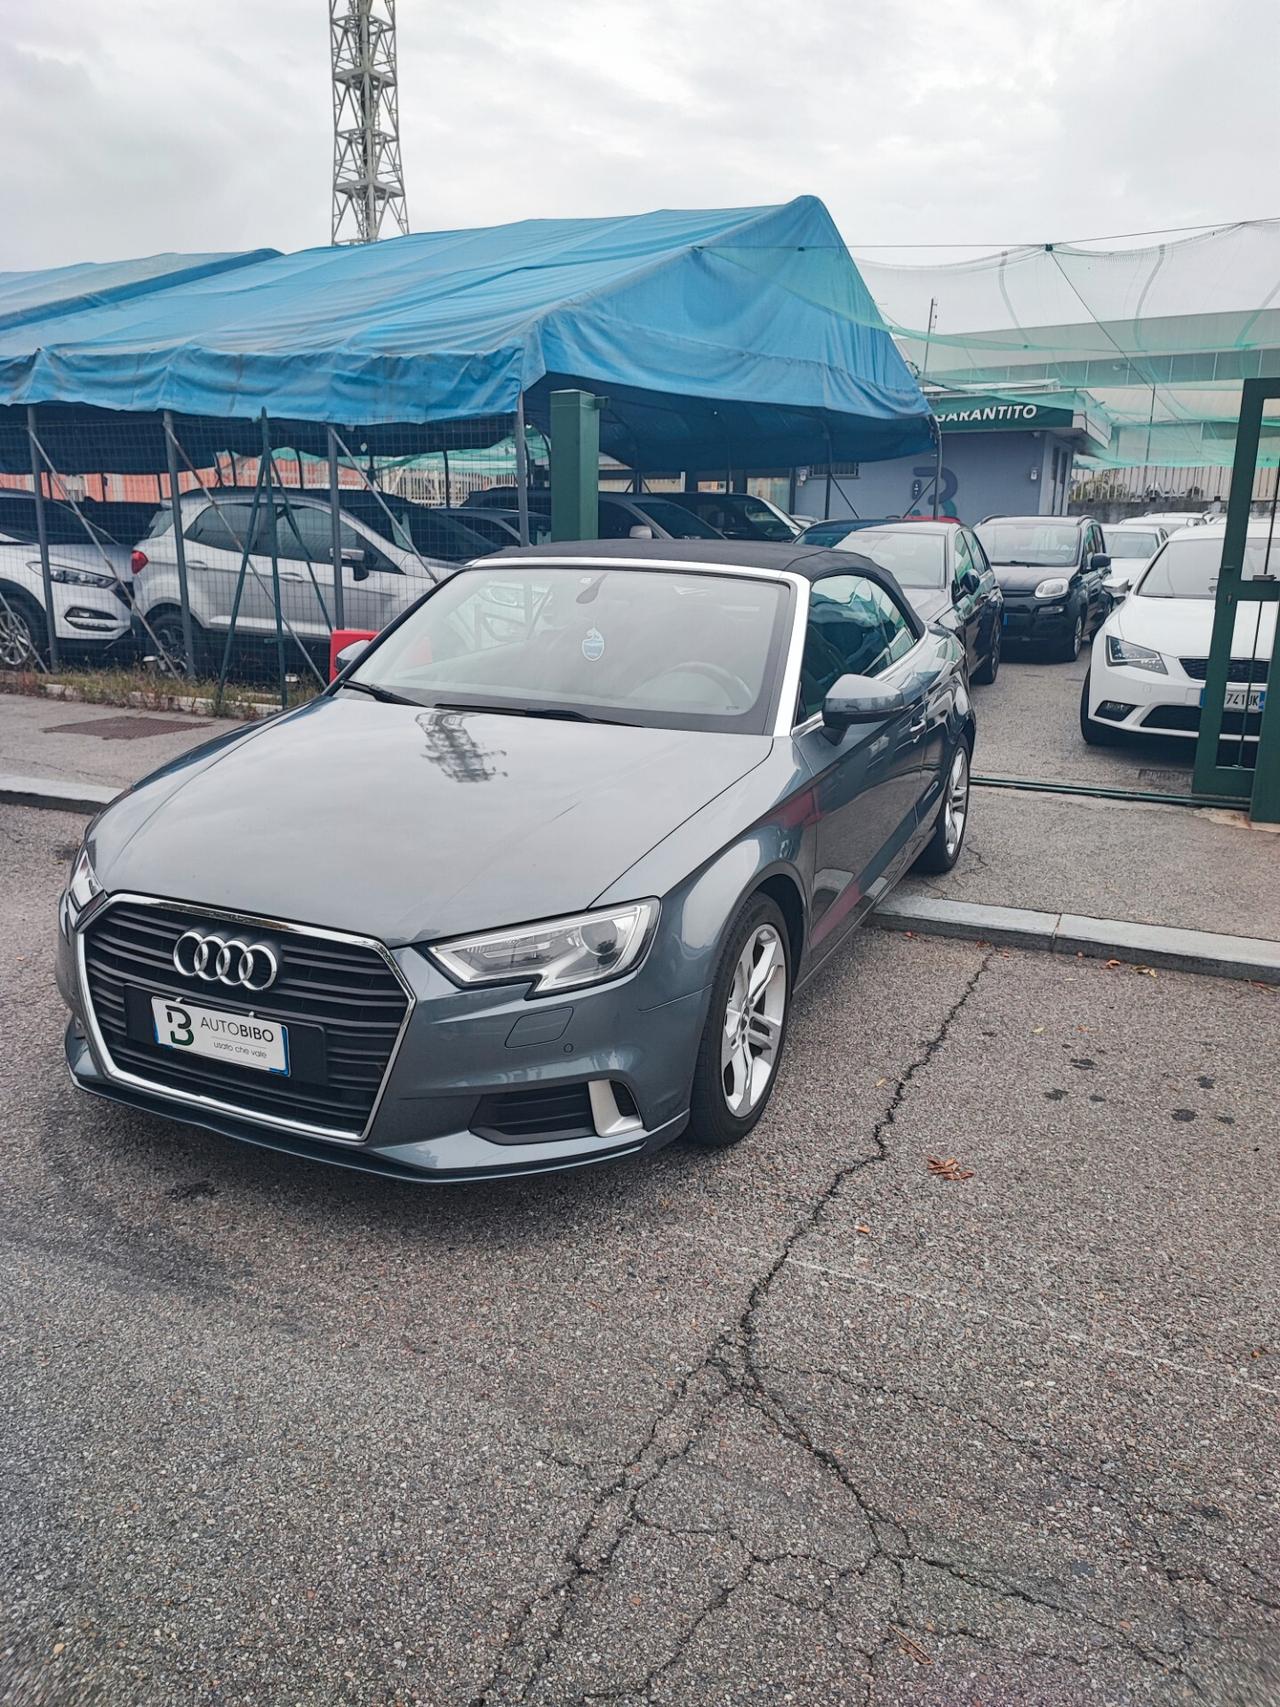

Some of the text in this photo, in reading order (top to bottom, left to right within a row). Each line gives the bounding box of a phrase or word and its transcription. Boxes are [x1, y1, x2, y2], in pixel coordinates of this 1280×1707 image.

[200, 1016, 274, 1043] AUTOBIBO
[213, 1041, 268, 1059] usato che vale
